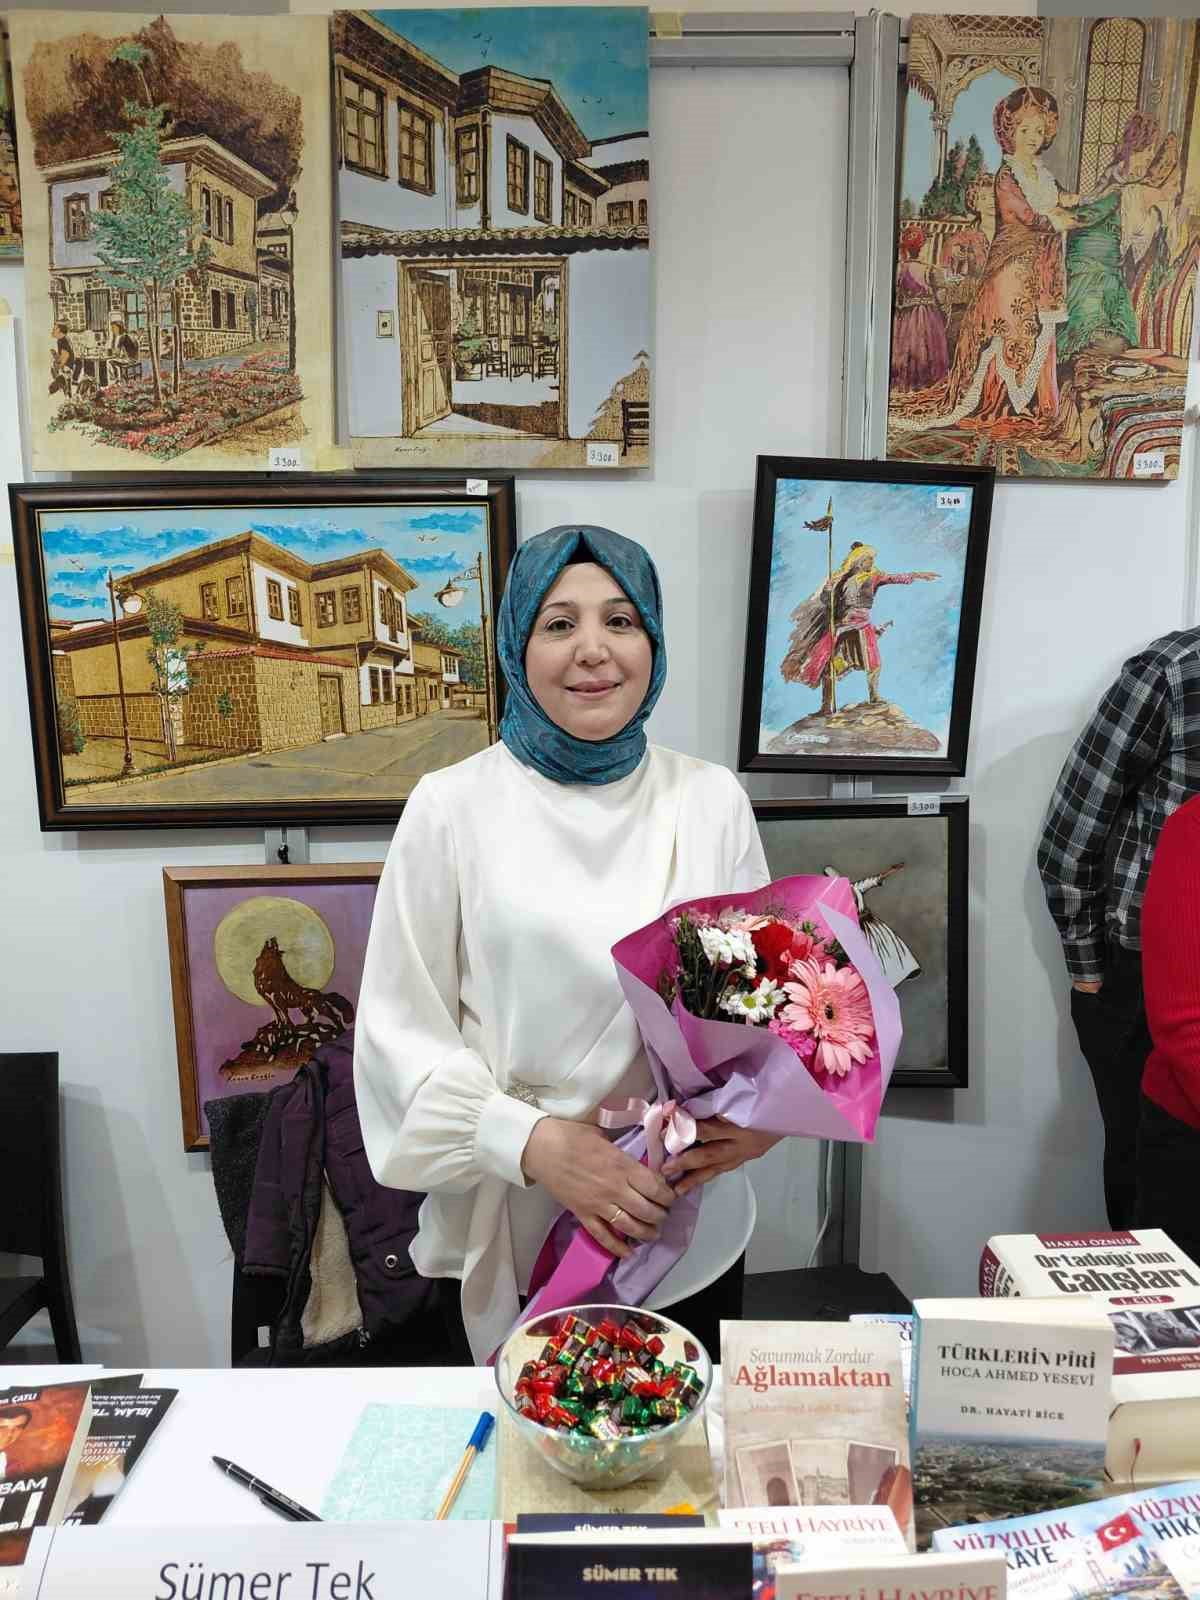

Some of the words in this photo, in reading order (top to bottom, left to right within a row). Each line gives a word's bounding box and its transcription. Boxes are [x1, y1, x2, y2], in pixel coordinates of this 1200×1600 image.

[750, 1348, 823, 1364] Savunmak
[824, 1348, 874, 1364] Zordur
[938, 1344, 1050, 1365] TÜRKLERİN
[735, 1365, 892, 1392] Ağlamaktan
[941, 1366, 981, 1379] HOCA
[985, 1368, 1039, 1382] AHMED
[155, 1562, 292, 1600] Sümer
[305, 1560, 376, 1600] Tek
[583, 1563, 641, 1581] SÜMER
[644, 1567, 678, 1581] TEK
